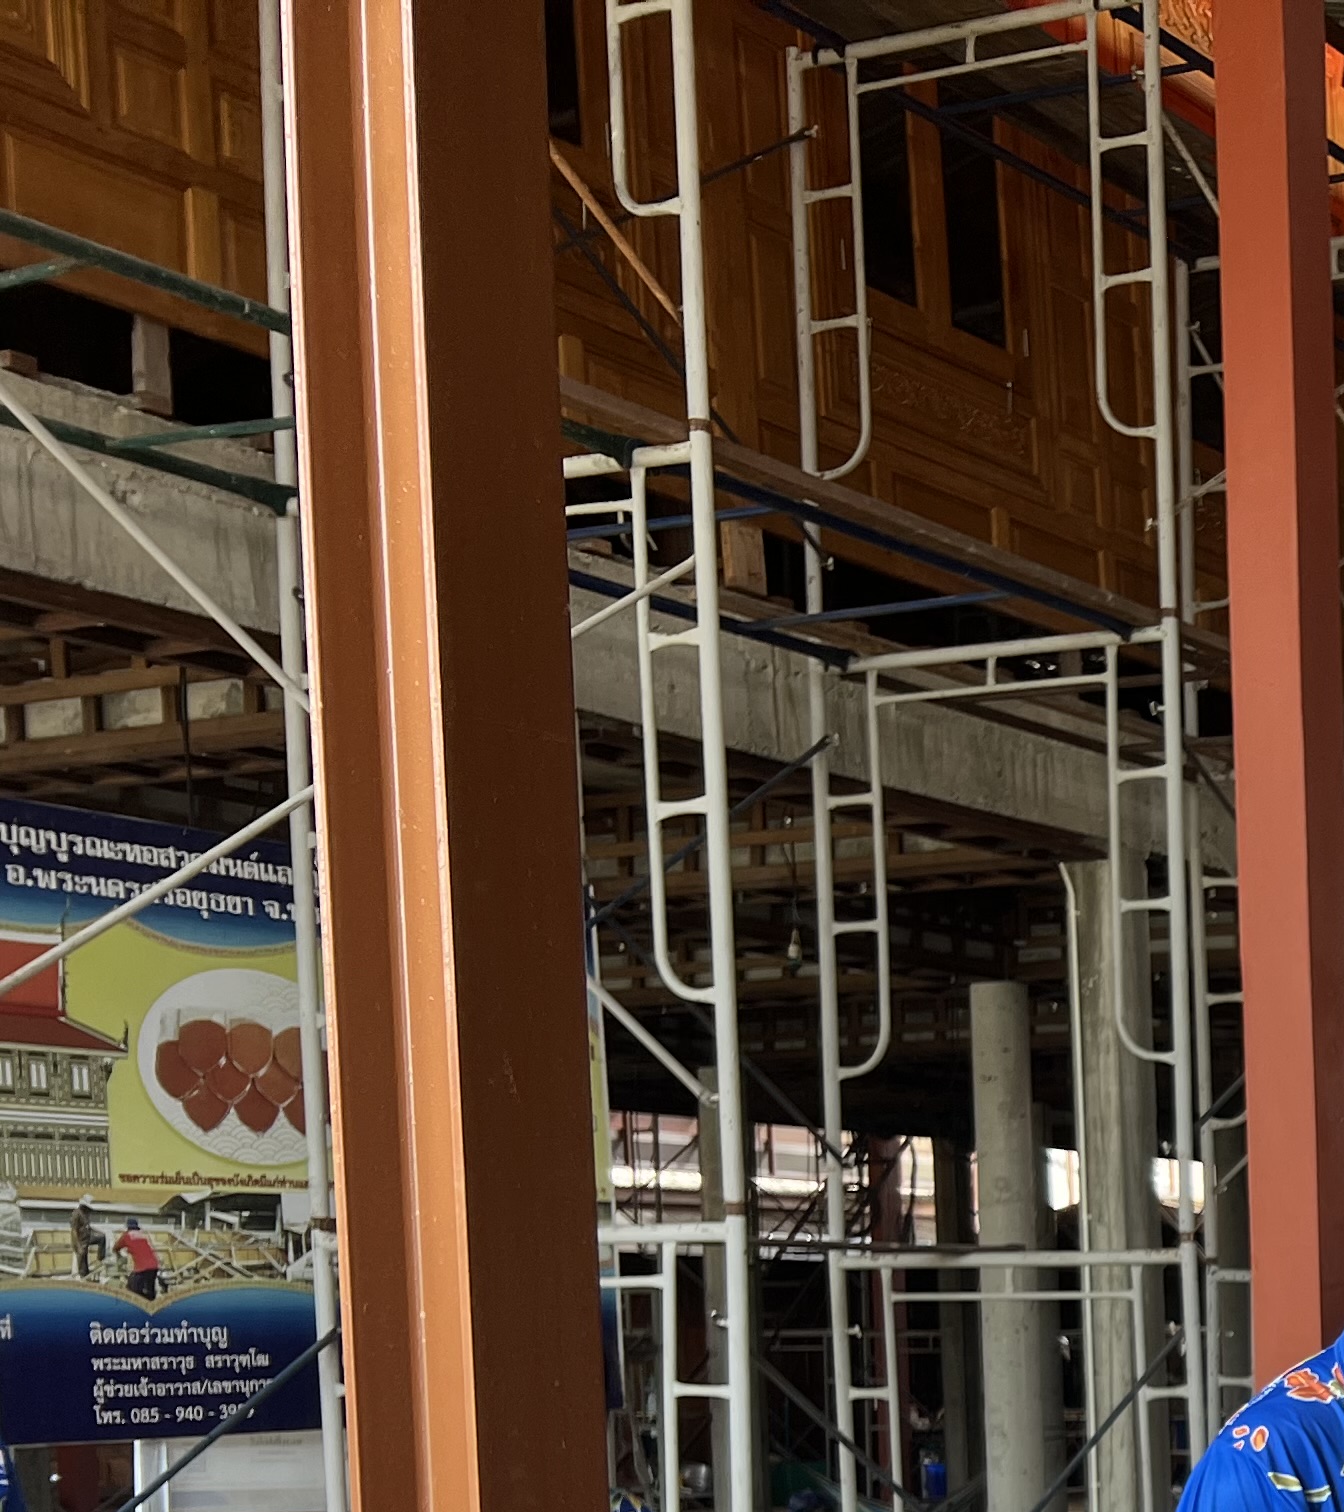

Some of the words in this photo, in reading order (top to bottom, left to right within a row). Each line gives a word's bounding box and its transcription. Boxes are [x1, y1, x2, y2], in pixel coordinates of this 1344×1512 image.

[89, 1319, 228, 1350] ติดต่อร่วมทำบุญ
[93, 1403, 125, 1425] โทร.
[130, 1406, 160, 1424] 085
[175, 1404, 204, 1422] 940
